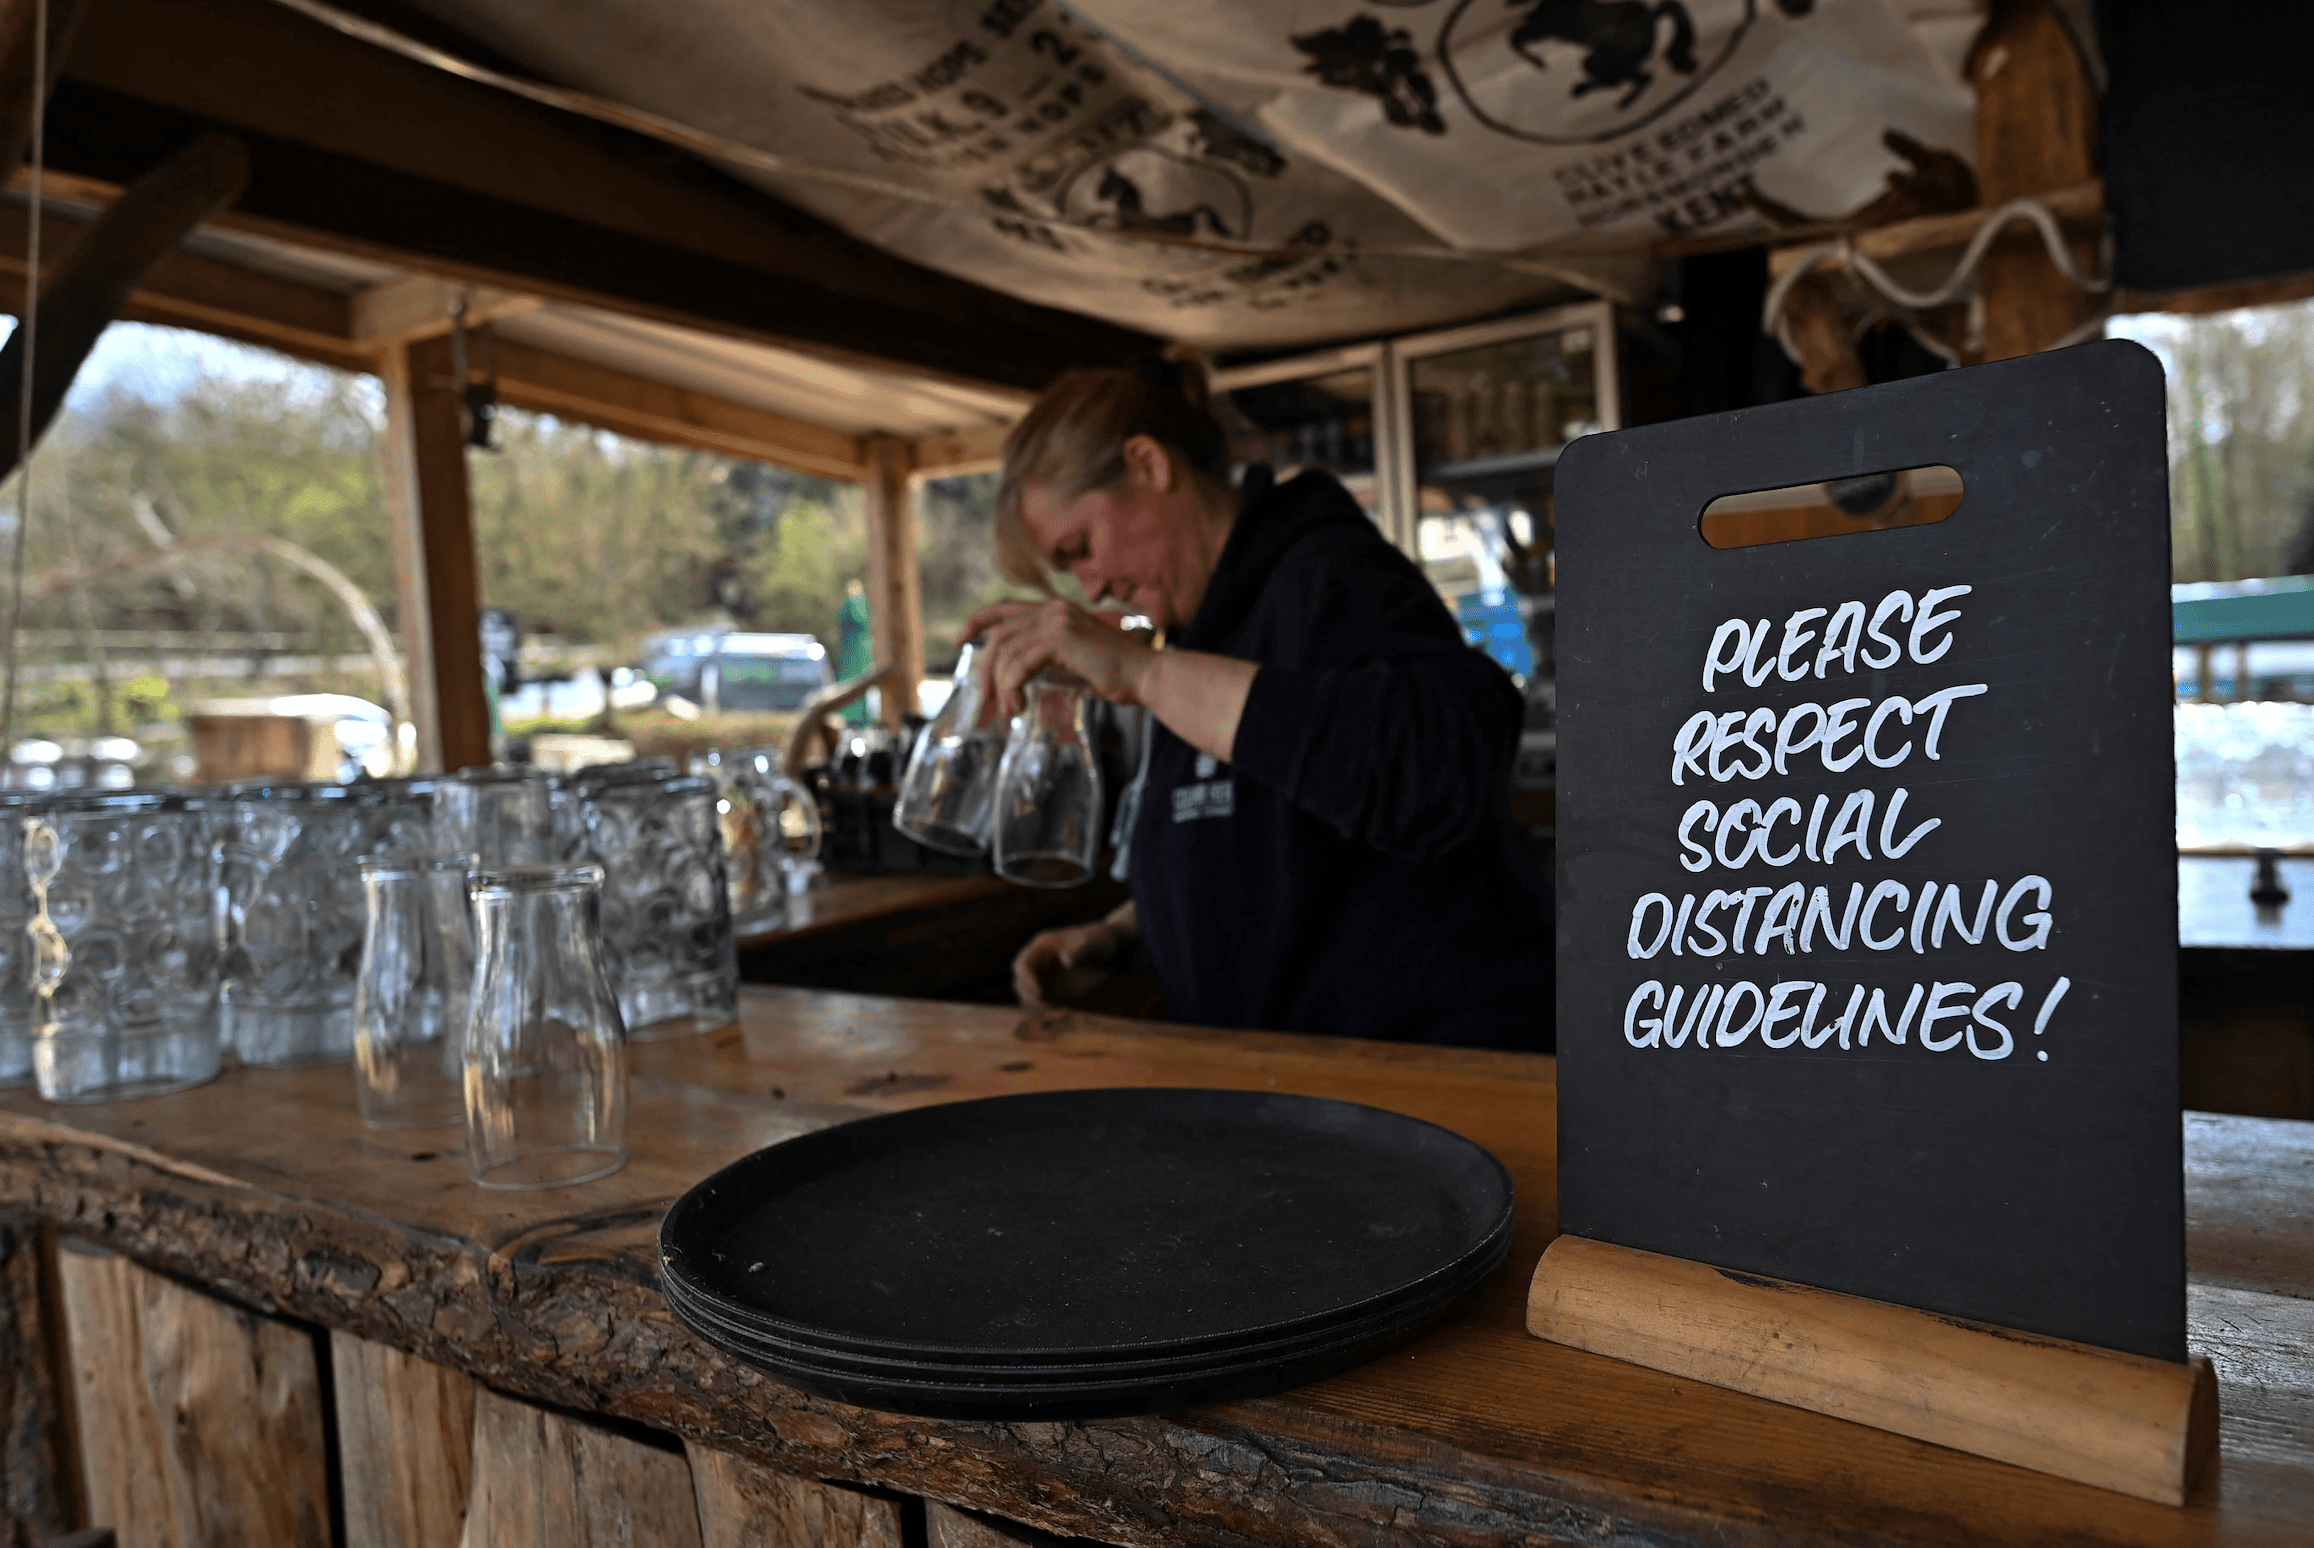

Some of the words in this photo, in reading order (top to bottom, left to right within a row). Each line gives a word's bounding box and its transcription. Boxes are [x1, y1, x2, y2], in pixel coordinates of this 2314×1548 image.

[1703, 585, 1972, 692] PLEASE
[1672, 684, 1988, 785] RESPECT
[1678, 788, 1941, 872] SOCIAL
[1627, 875, 2052, 959] DISTANCING
[1624, 977, 2070, 1061] GUIDELINES!
